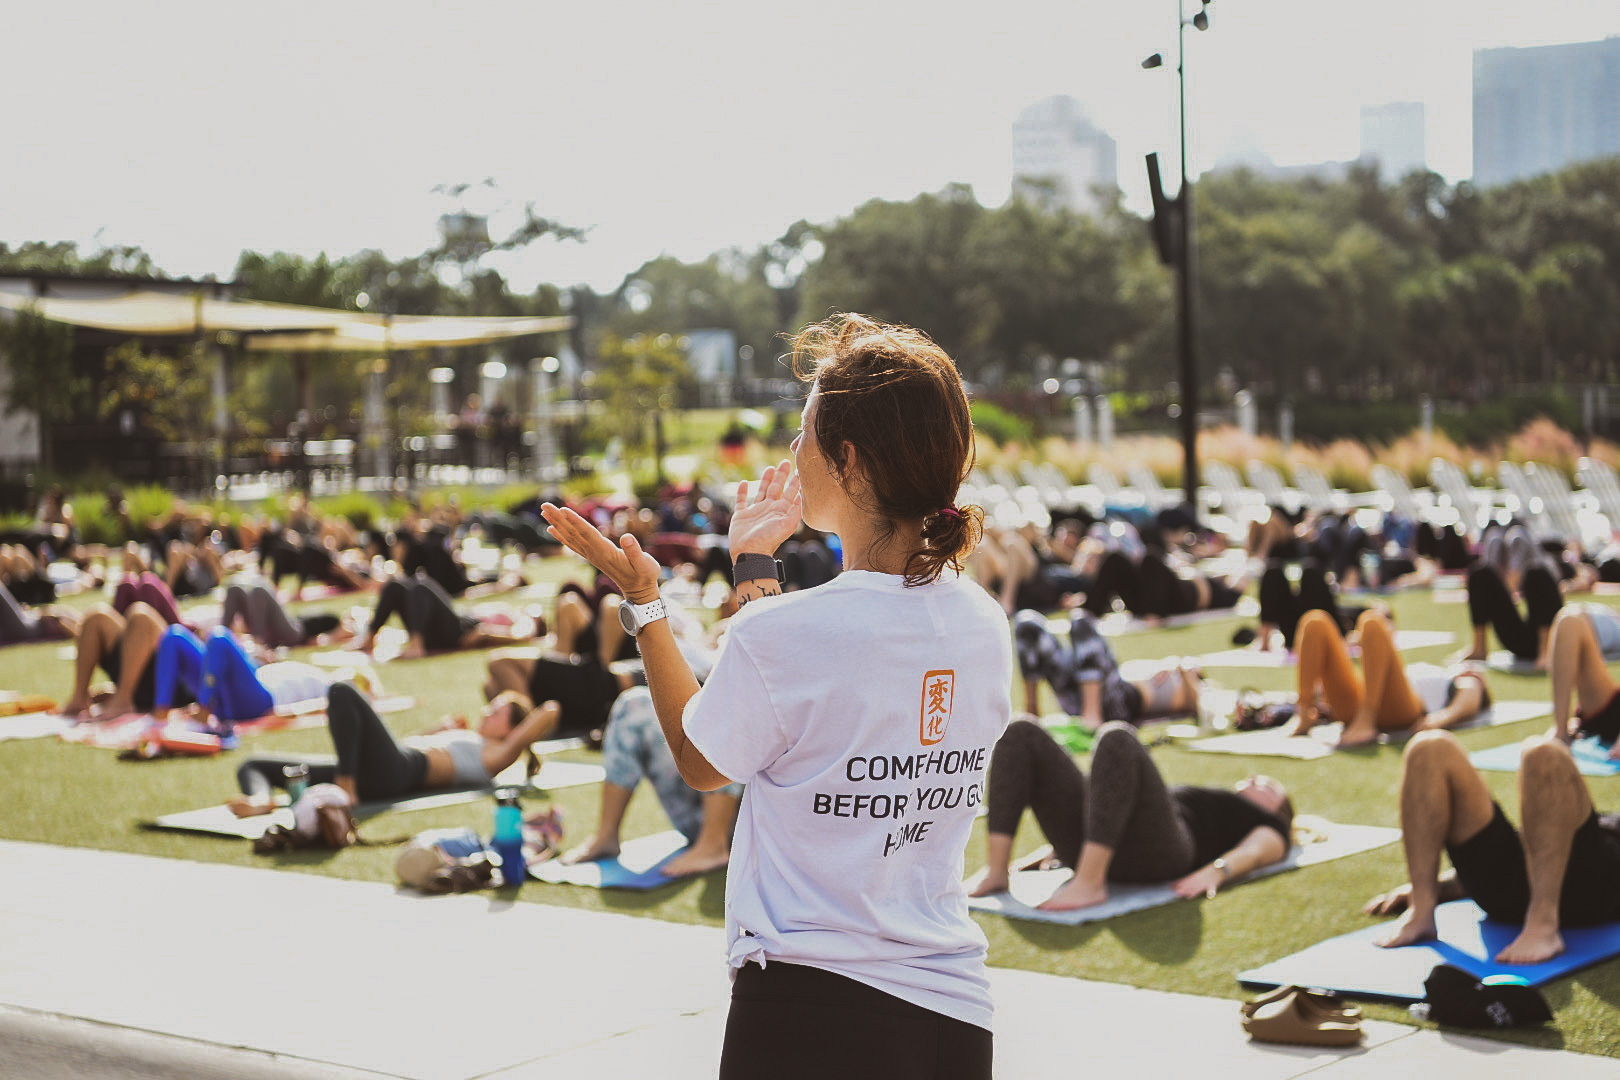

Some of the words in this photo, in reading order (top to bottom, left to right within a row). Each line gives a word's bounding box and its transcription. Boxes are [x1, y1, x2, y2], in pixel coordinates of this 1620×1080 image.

[928, 679, 948, 737] 変化
[846, 754, 927, 782] COME
[925, 748, 986, 775] HOME
[813, 793, 912, 820] BEFOR
[916, 787, 964, 811] YOU
